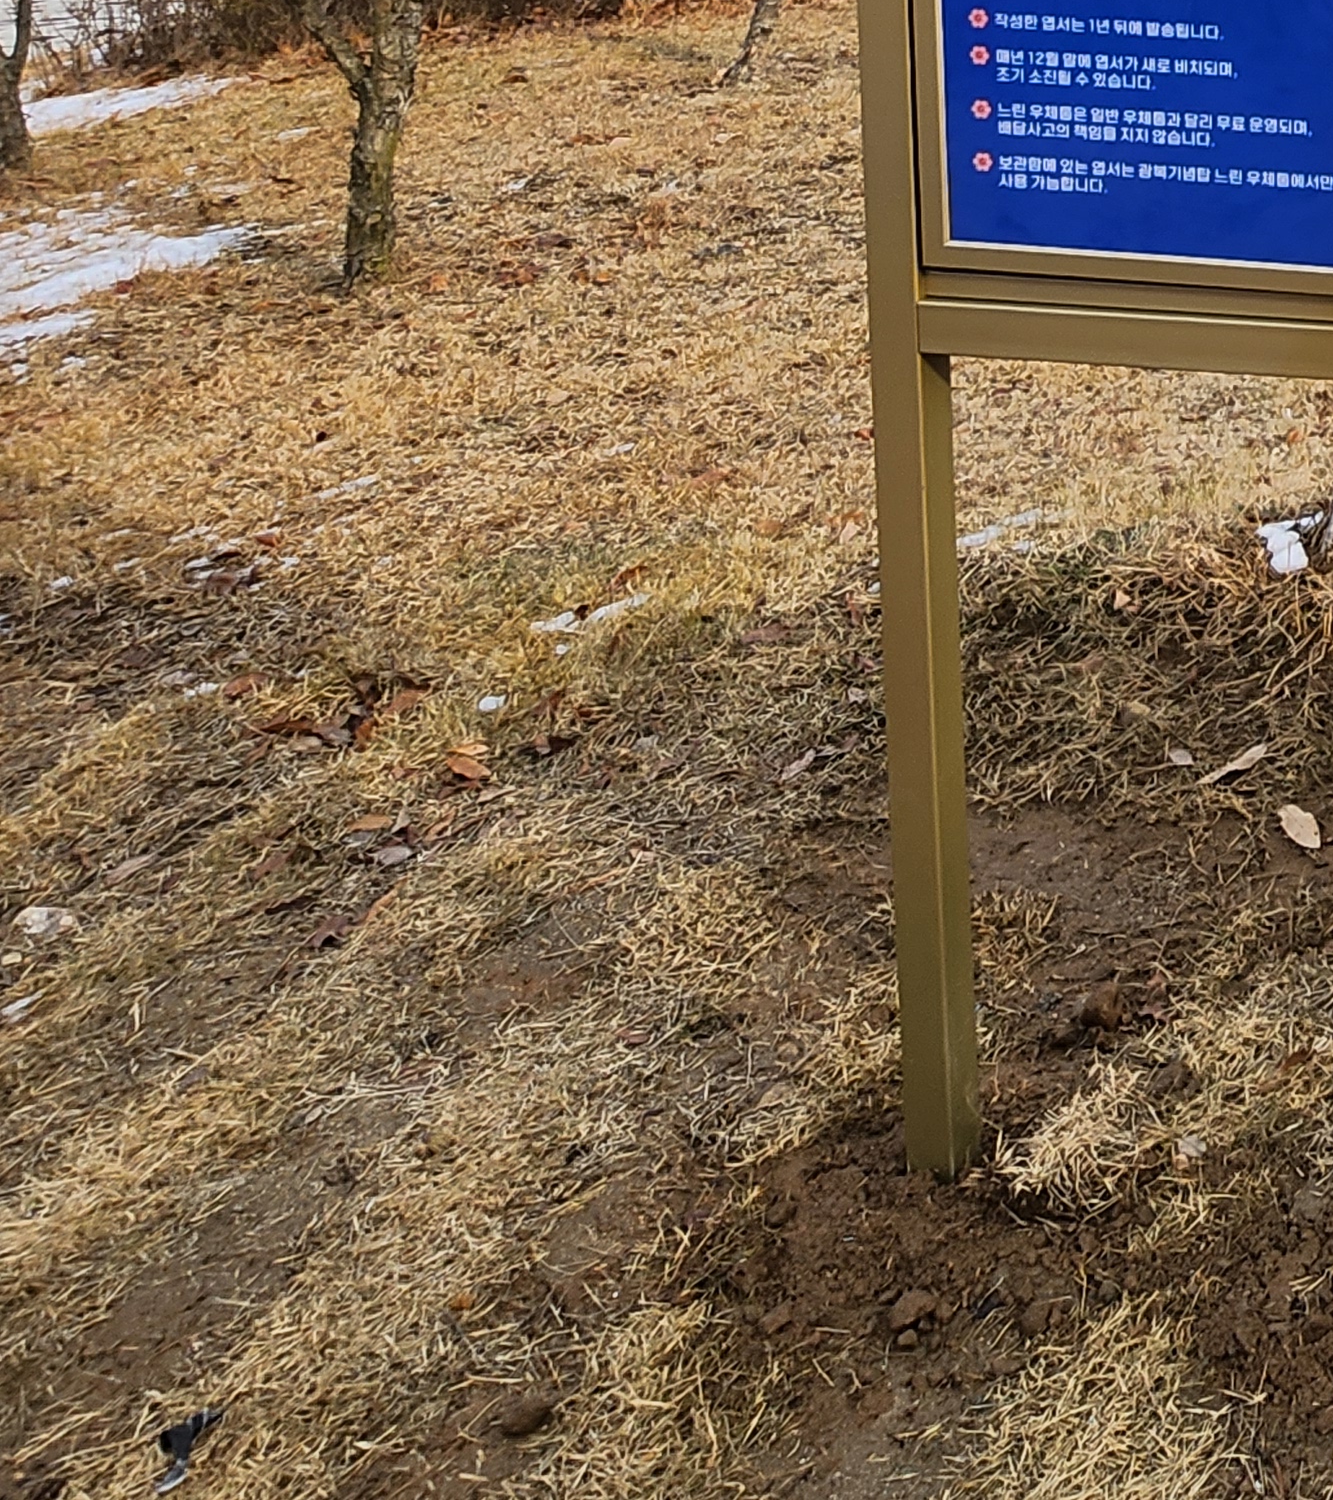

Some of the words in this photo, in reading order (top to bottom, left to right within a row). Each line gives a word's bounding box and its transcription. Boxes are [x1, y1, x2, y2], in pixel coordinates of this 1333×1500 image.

[994, 13, 1038, 30] 작성한
[1042, 15, 1085, 33] 엽서는
[1089, 18, 1110, 34] 1년
[1113, 19, 1142, 36] 뒤에
[1146, 21, 1224, 41] 발송됩니다.
[996, 49, 1024, 65] 매년
[1028, 51, 1059, 67] 12월
[1063, 52, 1092, 69] 말에
[1095, 54, 1138, 72] 엽서가
[1141, 56, 1171, 73] 새로
[1174, 59, 1238, 80] 비치되며,
[996, 67, 1024, 83] 조기
[1028, 69, 1071, 86] 소진될
[1075, 71, 1089, 86] 수
[1093, 72, 1156, 90] 있습니다.
[997, 102, 1026, 118] 느린
[1029, 104, 1087, 123] 우체통은
[1091, 108, 1119, 124] 일반
[1123, 109, 1180, 128] 우체통과
[1184, 113, 1213, 130] 달리
[1217, 115, 1246, 132] 무료
[1250, 117, 1313, 138] 운영되며,
[998, 120, 1070, 138] 배달사고의
[1074, 124, 1116, 141] 책임을
[1120, 126, 1149, 143] 지지
[1152, 129, 1216, 148] 않습니다.
[998, 173, 1027, 189] 사용
[1031, 175, 1108, 194] 가능합니다.
[999, 155, 1057, 173] 보관함에
[1060, 158, 1088, 175] 있는
[1091, 160, 1135, 178] 엽서는
[1138, 163, 1211, 183] 광복기념탑
[1214, 168, 1243, 185] 느린
